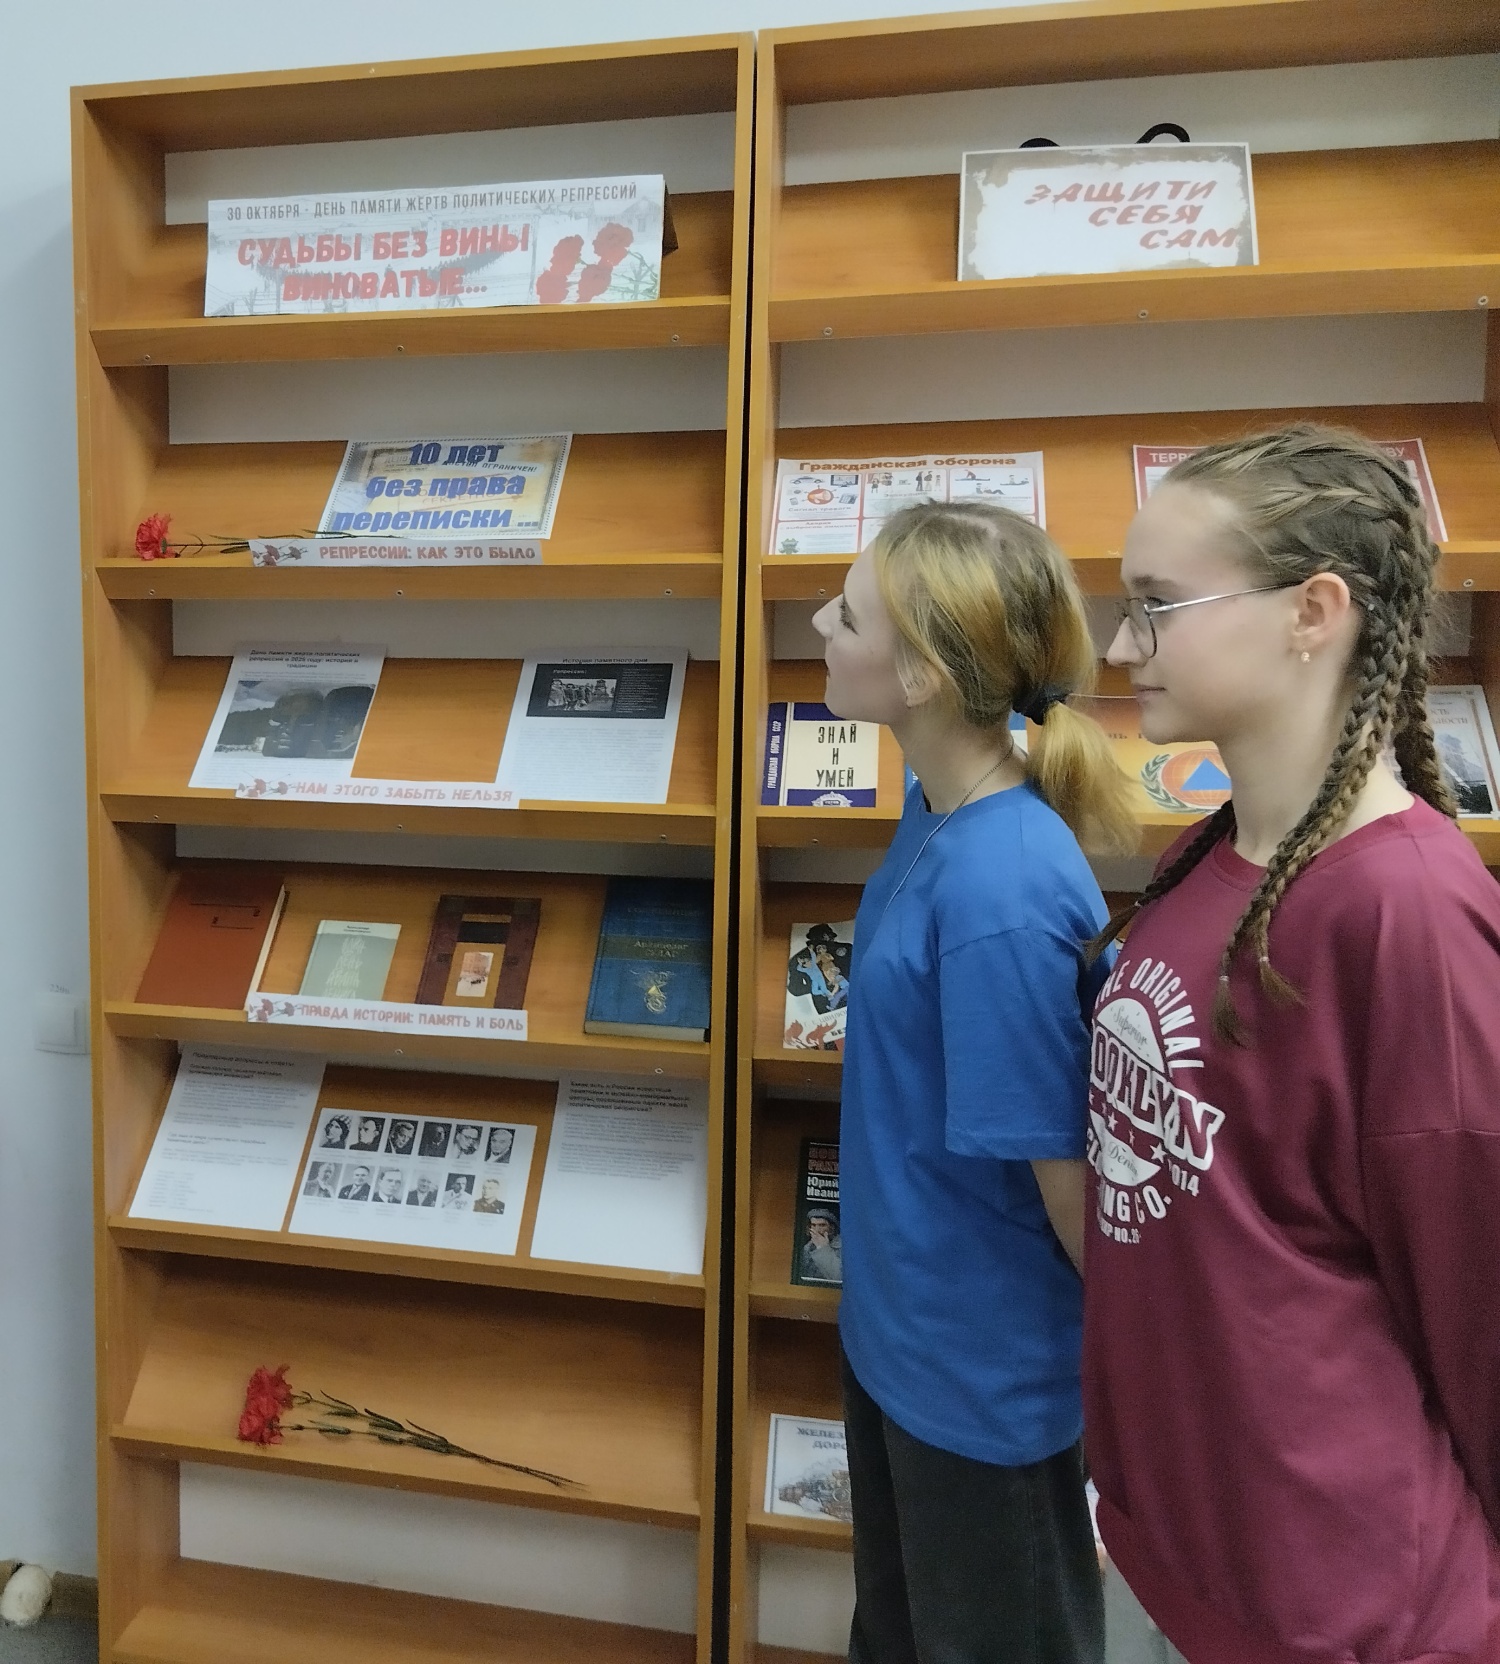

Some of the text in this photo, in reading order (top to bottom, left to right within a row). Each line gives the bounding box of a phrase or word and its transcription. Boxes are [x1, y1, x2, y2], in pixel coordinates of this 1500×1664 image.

[227, 206, 242, 220] 30
[246, 204, 300, 220] ОКТЯБРЯ
[314, 201, 346, 219] ДЕНЬ
[350, 198, 402, 215] ПАМЯТИ
[406, 194, 449, 212] ЖЕРТВ
[453, 189, 556, 209] ПОЛИТИЧЕСКИХ
[560, 182, 638, 202] РЕПРЕССИЙ
[1024, 180, 1217, 205] ЗАЩИТИ
[1088, 204, 1204, 227] СЕБЯ
[237, 223, 530, 268] СУДЬБЫ БЕЗ ВИНЫ
[1139, 228, 1238, 250] САМ
[282, 268, 488, 302] ВИНОВАТЫЕ...
[409, 442, 505, 466] 10 лет
[799, 457, 1016, 472] Гражданская оборона
[1149, 453, 1187, 462] ТЕРР
[482, 462, 538, 473] ОГРАНИЧЕН!
[365, 475, 527, 499] без права
[332, 508, 513, 533] переписки
[319, 546, 536, 560] РЕПРЕССИИ: КАК ЭТО БЫЛО
[771, 720, 782, 731] СССР
[818, 724, 856, 743] ЗНАЙ
[770, 735, 780, 754] ОБОРОНА
[816, 767, 854, 788] УМЕЙ
[295, 783, 512, 802] НАМ ЭТОГО ЗАБЫТЬ НЕЛЬЗЯ
[301, 1004, 523, 1031] ПРАВДА ИСТОРИИ: ПАМЯТЬ И БОЛЬ
[1130, 957, 1205, 1077] ORIGINAL
[1090, 1018, 1225, 1171] OOKLYN
[807, 1186, 840, 1198] Ивани
[808, 1176, 839, 1188] Юрий
[1135, 1185, 1173, 1224] CO.
[797, 1427, 845, 1439] ЖЕЛЕЗ
